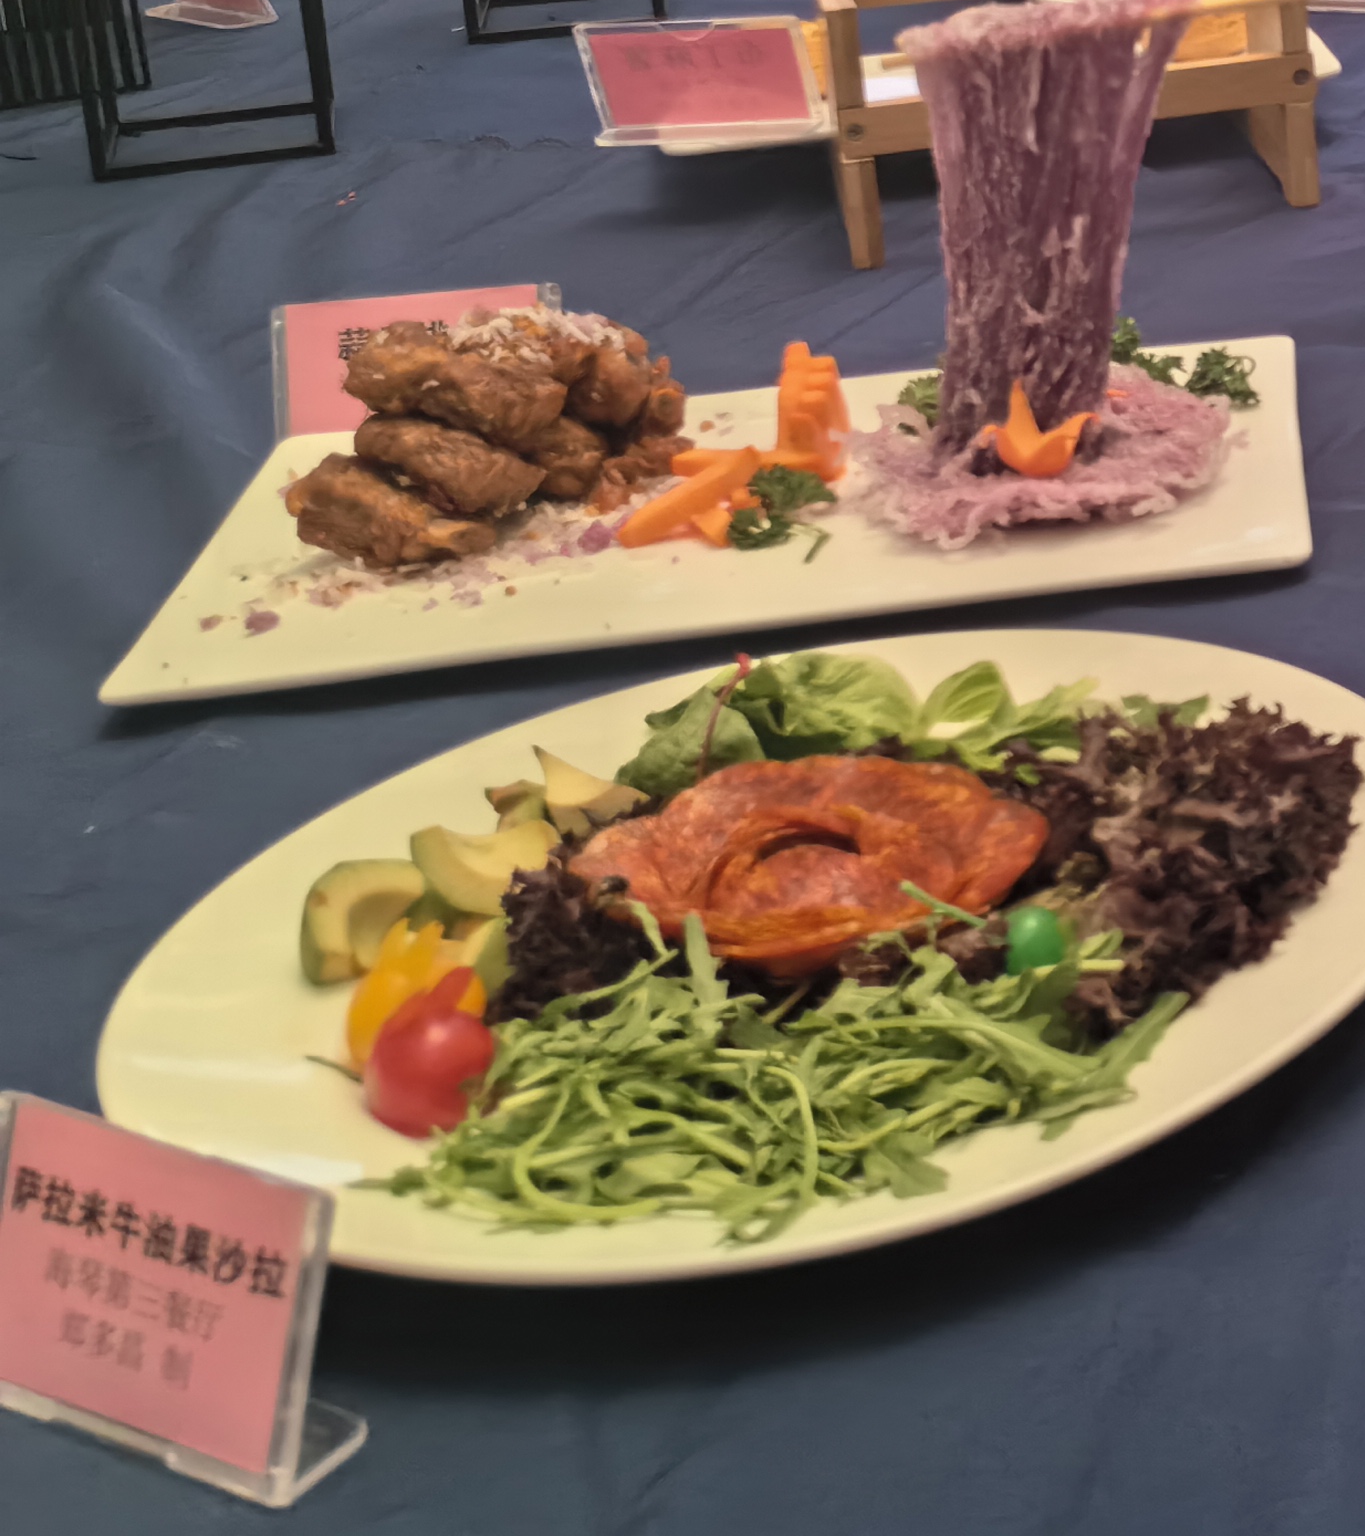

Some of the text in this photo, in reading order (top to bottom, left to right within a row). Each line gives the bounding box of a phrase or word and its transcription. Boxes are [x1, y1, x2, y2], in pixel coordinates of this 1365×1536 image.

[9, 1165, 289, 1300] 萨拉米牛油果沙拉
